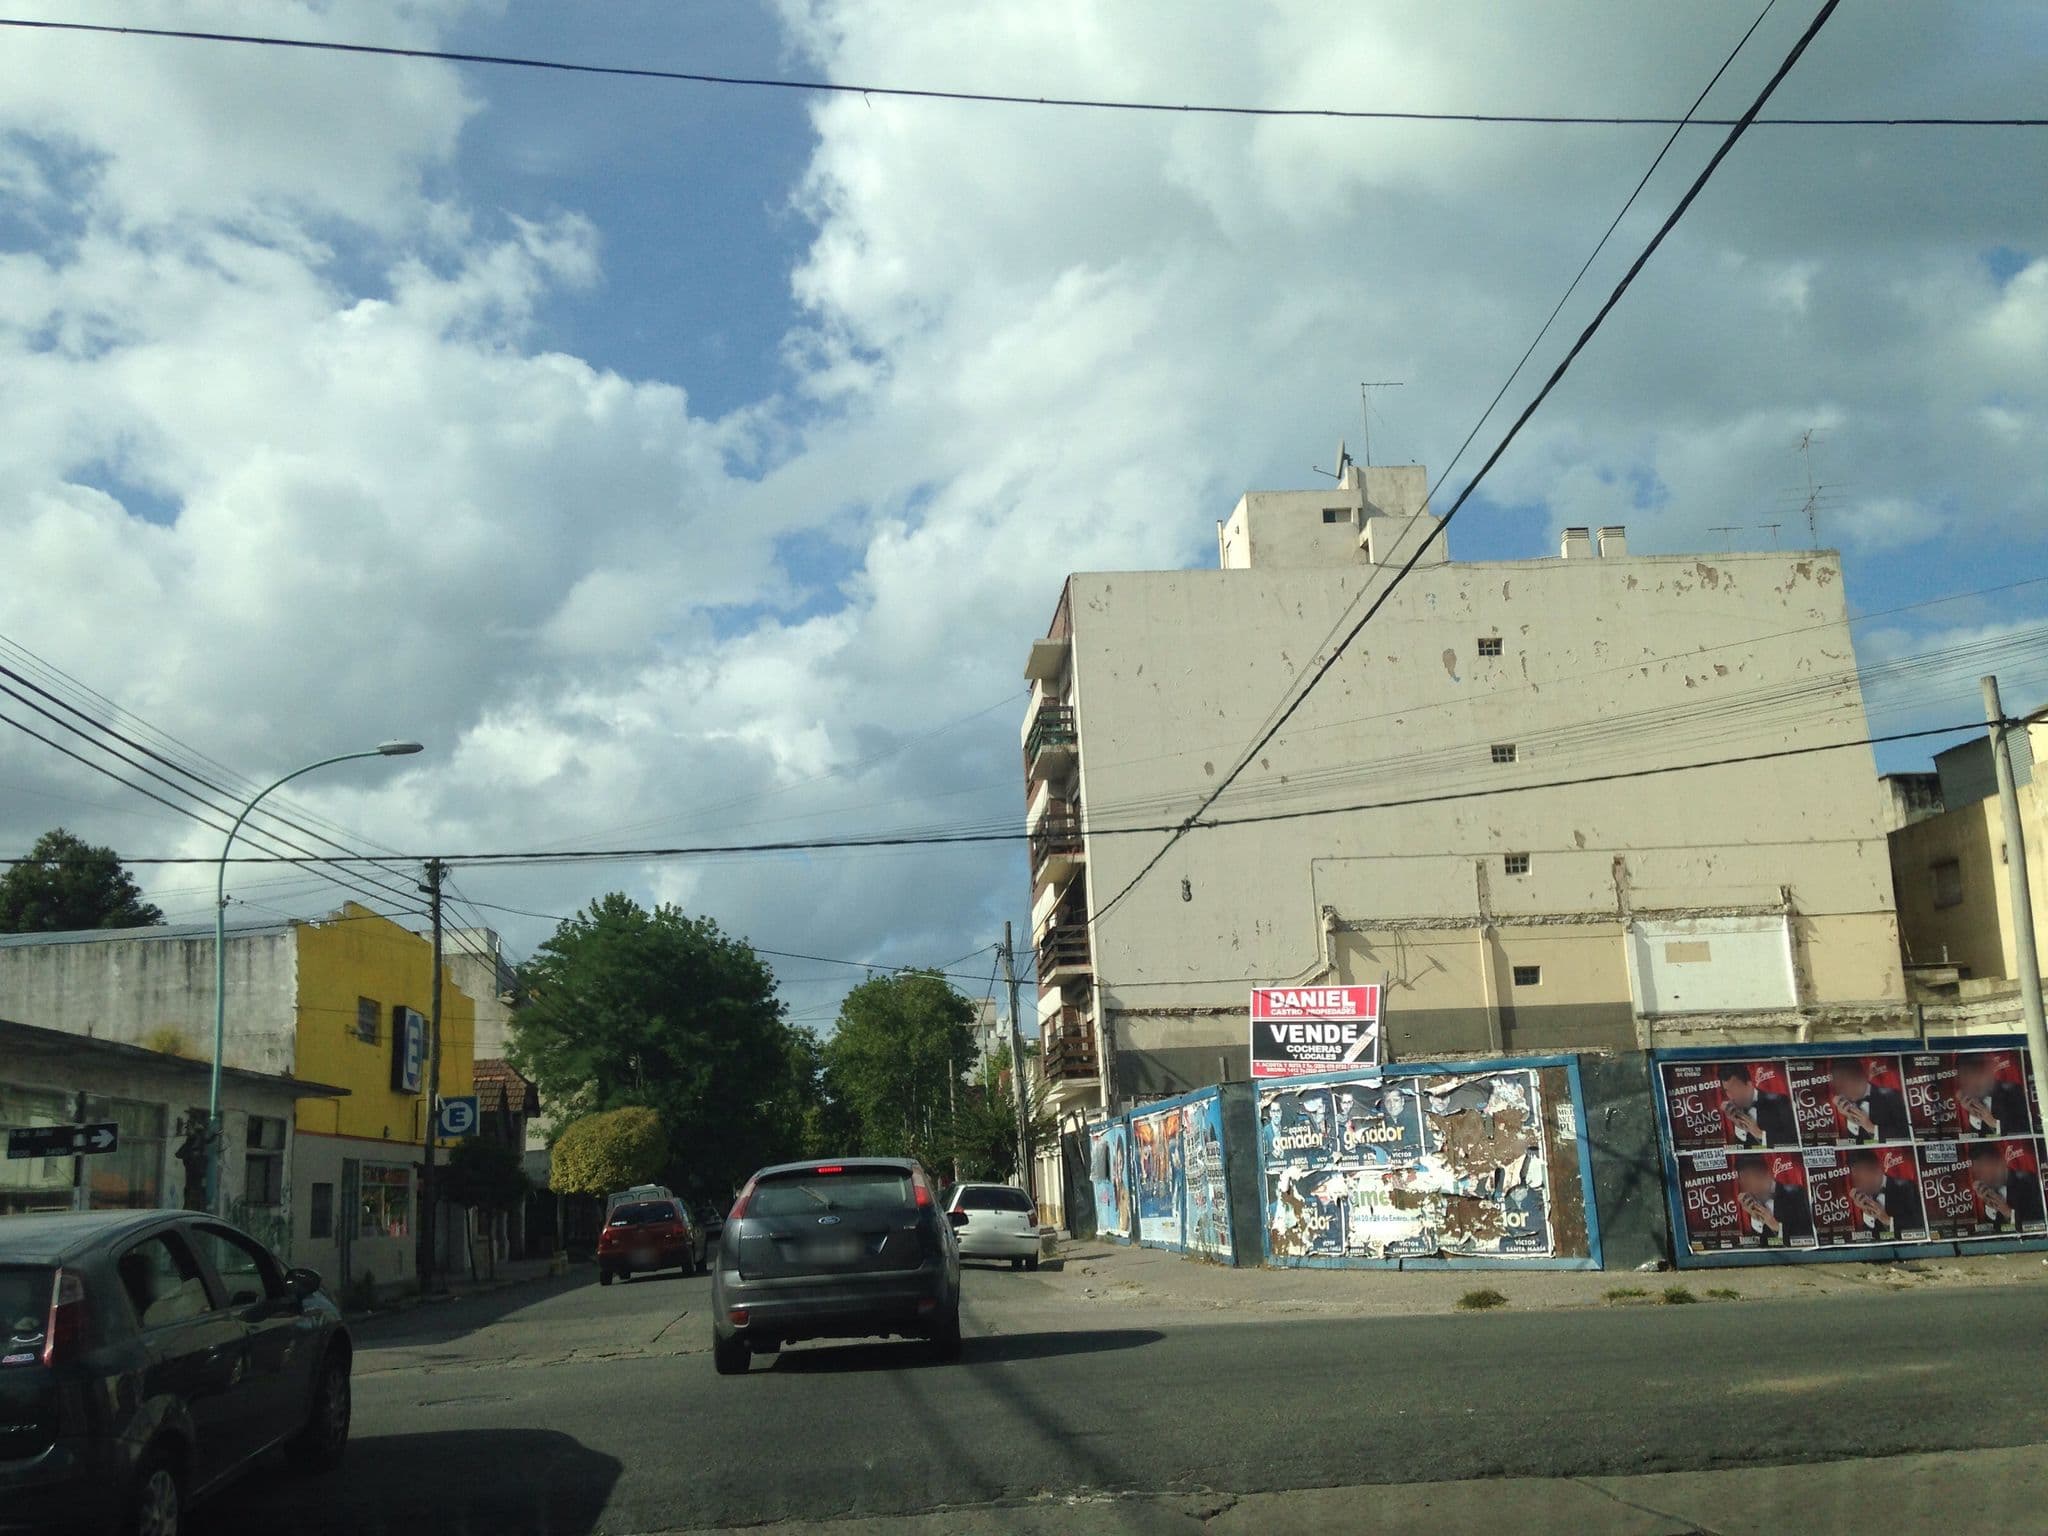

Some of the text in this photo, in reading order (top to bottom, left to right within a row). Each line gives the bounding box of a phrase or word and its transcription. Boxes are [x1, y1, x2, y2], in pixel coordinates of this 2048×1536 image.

[1270, 990, 1356, 1008] DANIEL
[1270, 1024, 1358, 1043] VENDE
[1286, 1045, 1342, 1053] COCHERAS
[1791, 1078, 1810, 1089] RTIN
[1906, 1069, 1959, 1085] MARTIN BOSSI
[1668, 1080, 1721, 1097] MARTIN BOSSI
[1908, 1083, 1940, 1107] BIG
[1671, 1094, 1704, 1119] BIG
[1794, 1088, 1816, 1109] IG
[1923, 1098, 1956, 1117] BANG
[449, 1107, 466, 1127] E
[1686, 1109, 1721, 1128] BANG
[1798, 1103, 1833, 1122] BANG
[1695, 1123, 1722, 1137] SHOW
[1806, 1116, 1835, 1131] SHOW
[1272, 1126, 1324, 1151] ganador
[1809, 1167, 1850, 1183] RTIN BOSSI
[1921, 1159, 1973, 1178] MARTIN BOSSI
[1685, 1171, 1738, 1188] MARTIN BOSSI
[1923, 1175, 1956, 1200] BIG
[1687, 1186, 1720, 1210] BIG
[1812, 1182, 1832, 1203] IG
[1938, 1189, 1972, 1209] BANG
[1702, 1201, 1737, 1219] BANG
[1815, 1196, 1850, 1216] BANG
[1946, 1202, 1973, 1217] SHOW
[1710, 1214, 1738, 1229] SHOW
[1823, 1210, 1850, 1225] SHOW
